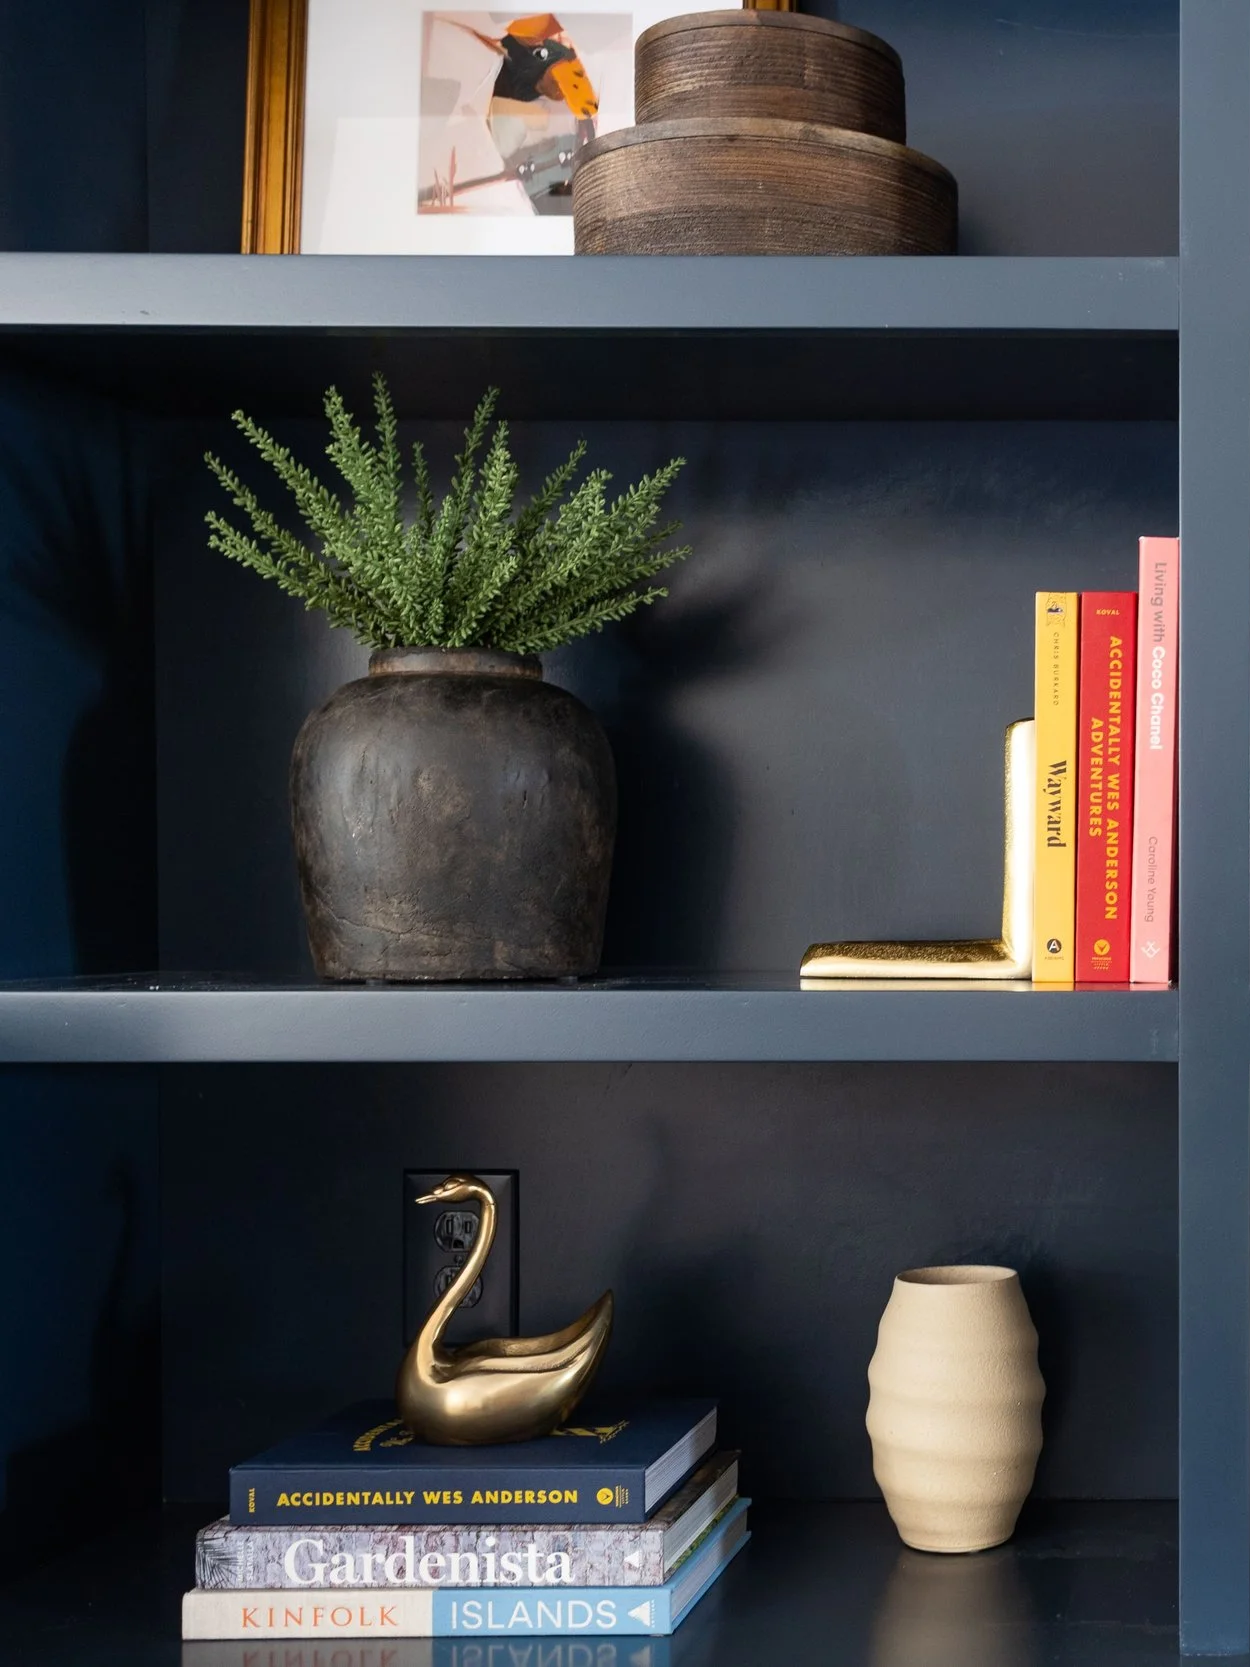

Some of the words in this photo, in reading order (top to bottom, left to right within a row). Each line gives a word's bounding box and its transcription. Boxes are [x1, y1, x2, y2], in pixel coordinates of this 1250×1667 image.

[1152, 562, 1167, 606] Living
[1153, 609, 1166, 642] with
[1152, 646, 1166, 690] Coco
[1107, 635, 1123, 766] ACCIDENTALLY
[1150, 692, 1165, 750] Chanel
[1088, 717, 1104, 838] ADVENTURES
[1106, 773, 1120, 811] WES
[1043, 760, 1067, 848] Wayward
[1104, 818, 1120, 920] ANDERSON
[1147, 836, 1158, 885] Caroline
[1144, 887, 1157, 923] Young
[276, 1491, 415, 1506] ACCIDENTALLY
[423, 1490, 463, 1504] WES
[470, 1489, 578, 1504] ANDERSON
[284, 1535, 575, 1586] Gardenista
[242, 1606, 398, 1628] KINFOLK
[451, 1599, 617, 1630] ISLANDS
